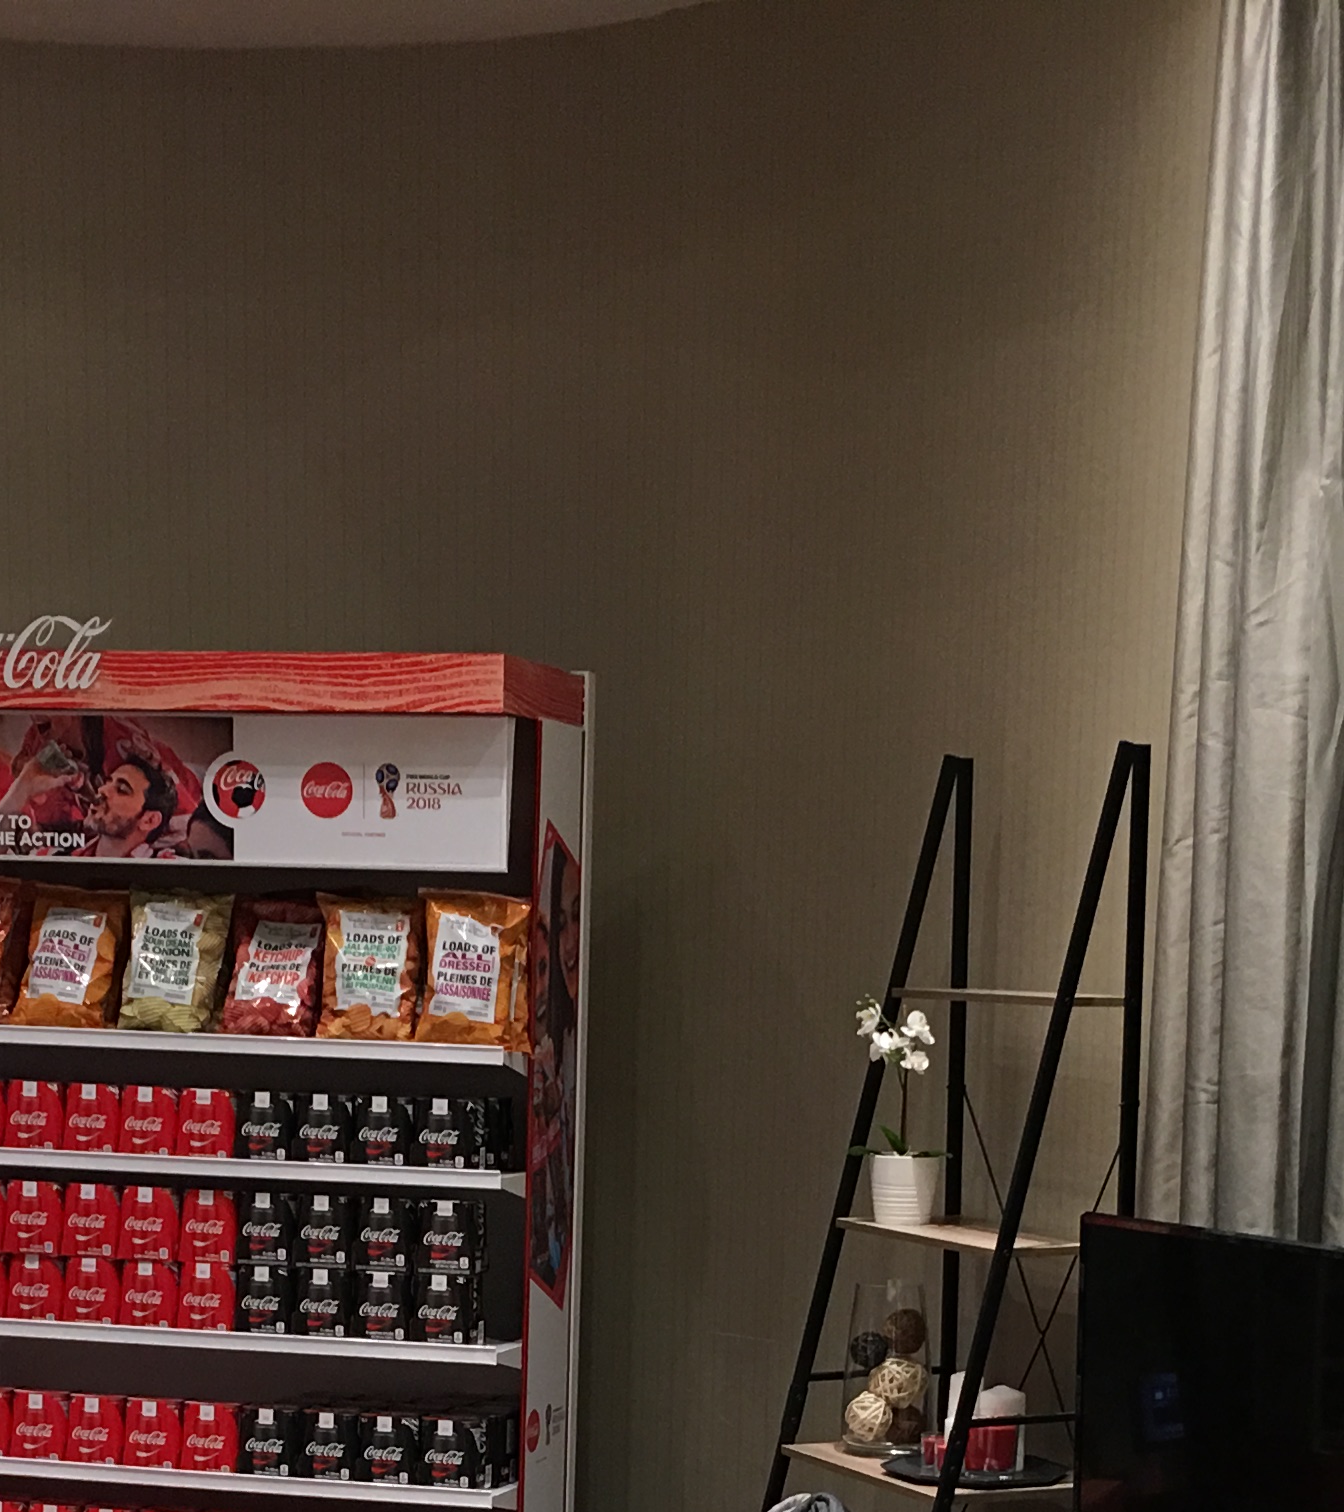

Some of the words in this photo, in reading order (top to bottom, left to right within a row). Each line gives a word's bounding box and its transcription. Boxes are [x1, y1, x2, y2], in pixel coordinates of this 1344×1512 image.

[303, 780, 351, 800] Coca-Cola
[405, 782, 463, 796] RUSSIA
[406, 796, 442, 811] 2018
[8, 814, 32, 830] TO
[20, 831, 86, 848] ACTION
[42, 928, 78, 944] LOADS
[79, 935, 95, 947] OF
[144, 925, 178, 939] LOADS
[179, 930, 195, 941] OF
[346, 932, 385, 945] LOADS
[387, 933, 402, 945] OF
[154, 947, 191, 958] ONION
[254, 947, 306, 962] KETCHUP
[442, 940, 479, 953] LOADS
[481, 943, 497, 956] OF
[441, 951, 493, 962] ALL
[438, 958, 492, 974] DRESSED
[436, 970, 479, 986] PLEINES
[479, 975, 494, 987] DE
